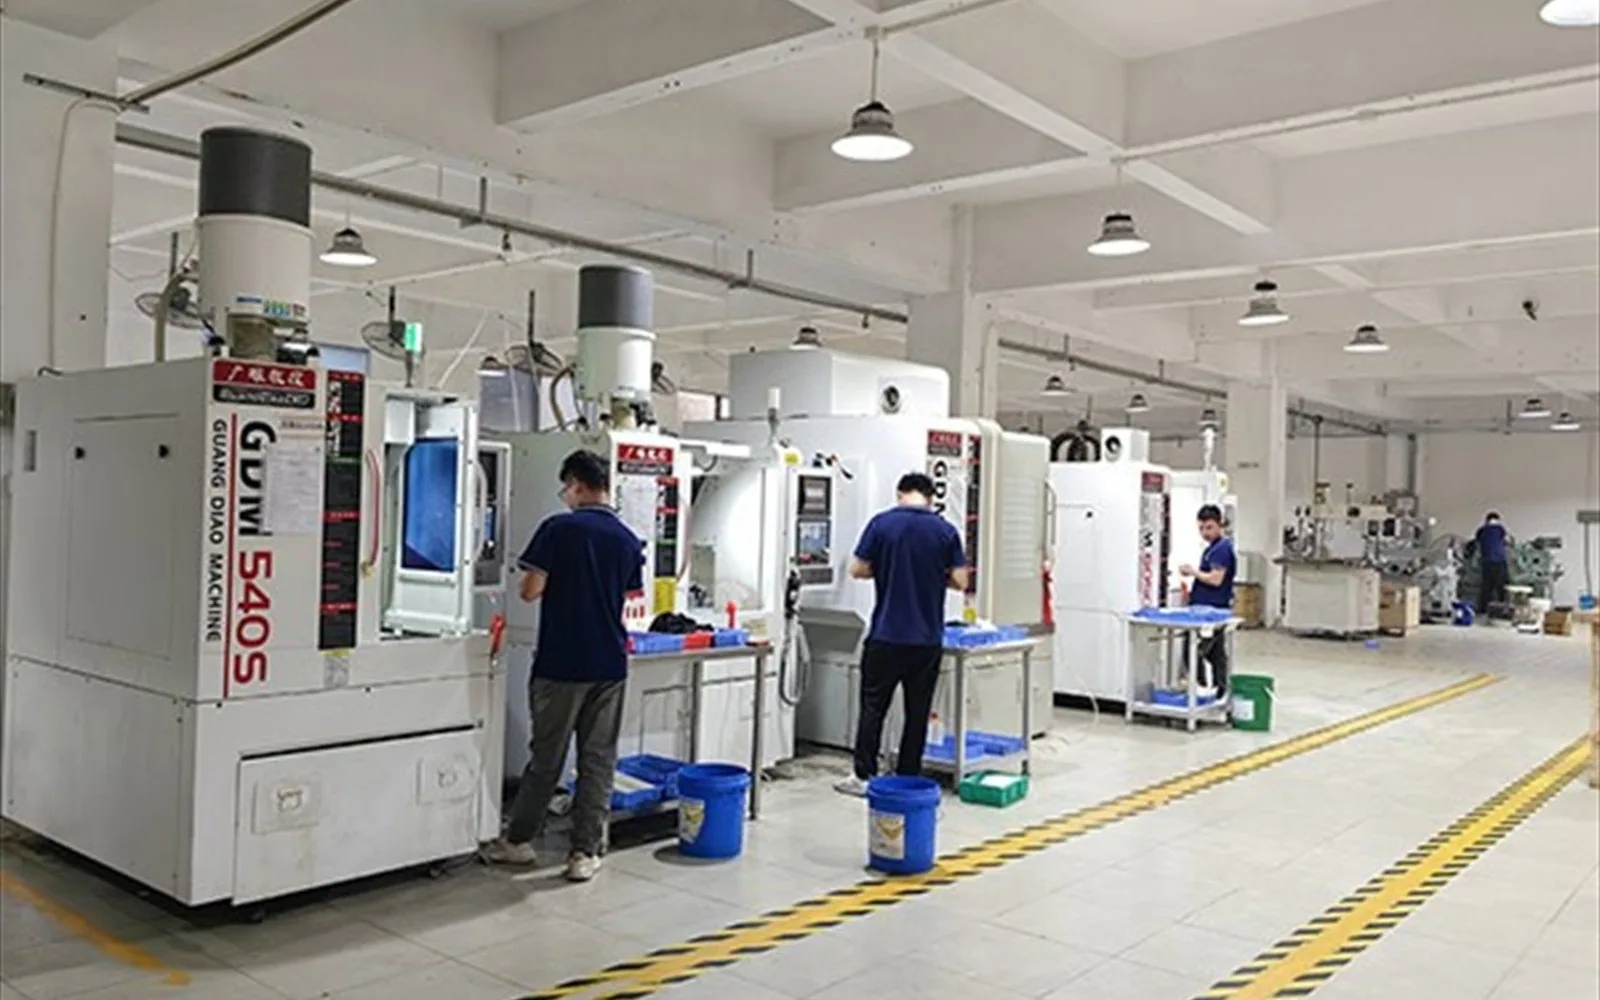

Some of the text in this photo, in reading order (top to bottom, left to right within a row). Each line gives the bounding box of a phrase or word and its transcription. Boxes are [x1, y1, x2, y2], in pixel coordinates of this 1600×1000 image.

[206, 418, 227, 642] GUANG DIAO MACHINE
[233, 551, 272, 684] 540S
